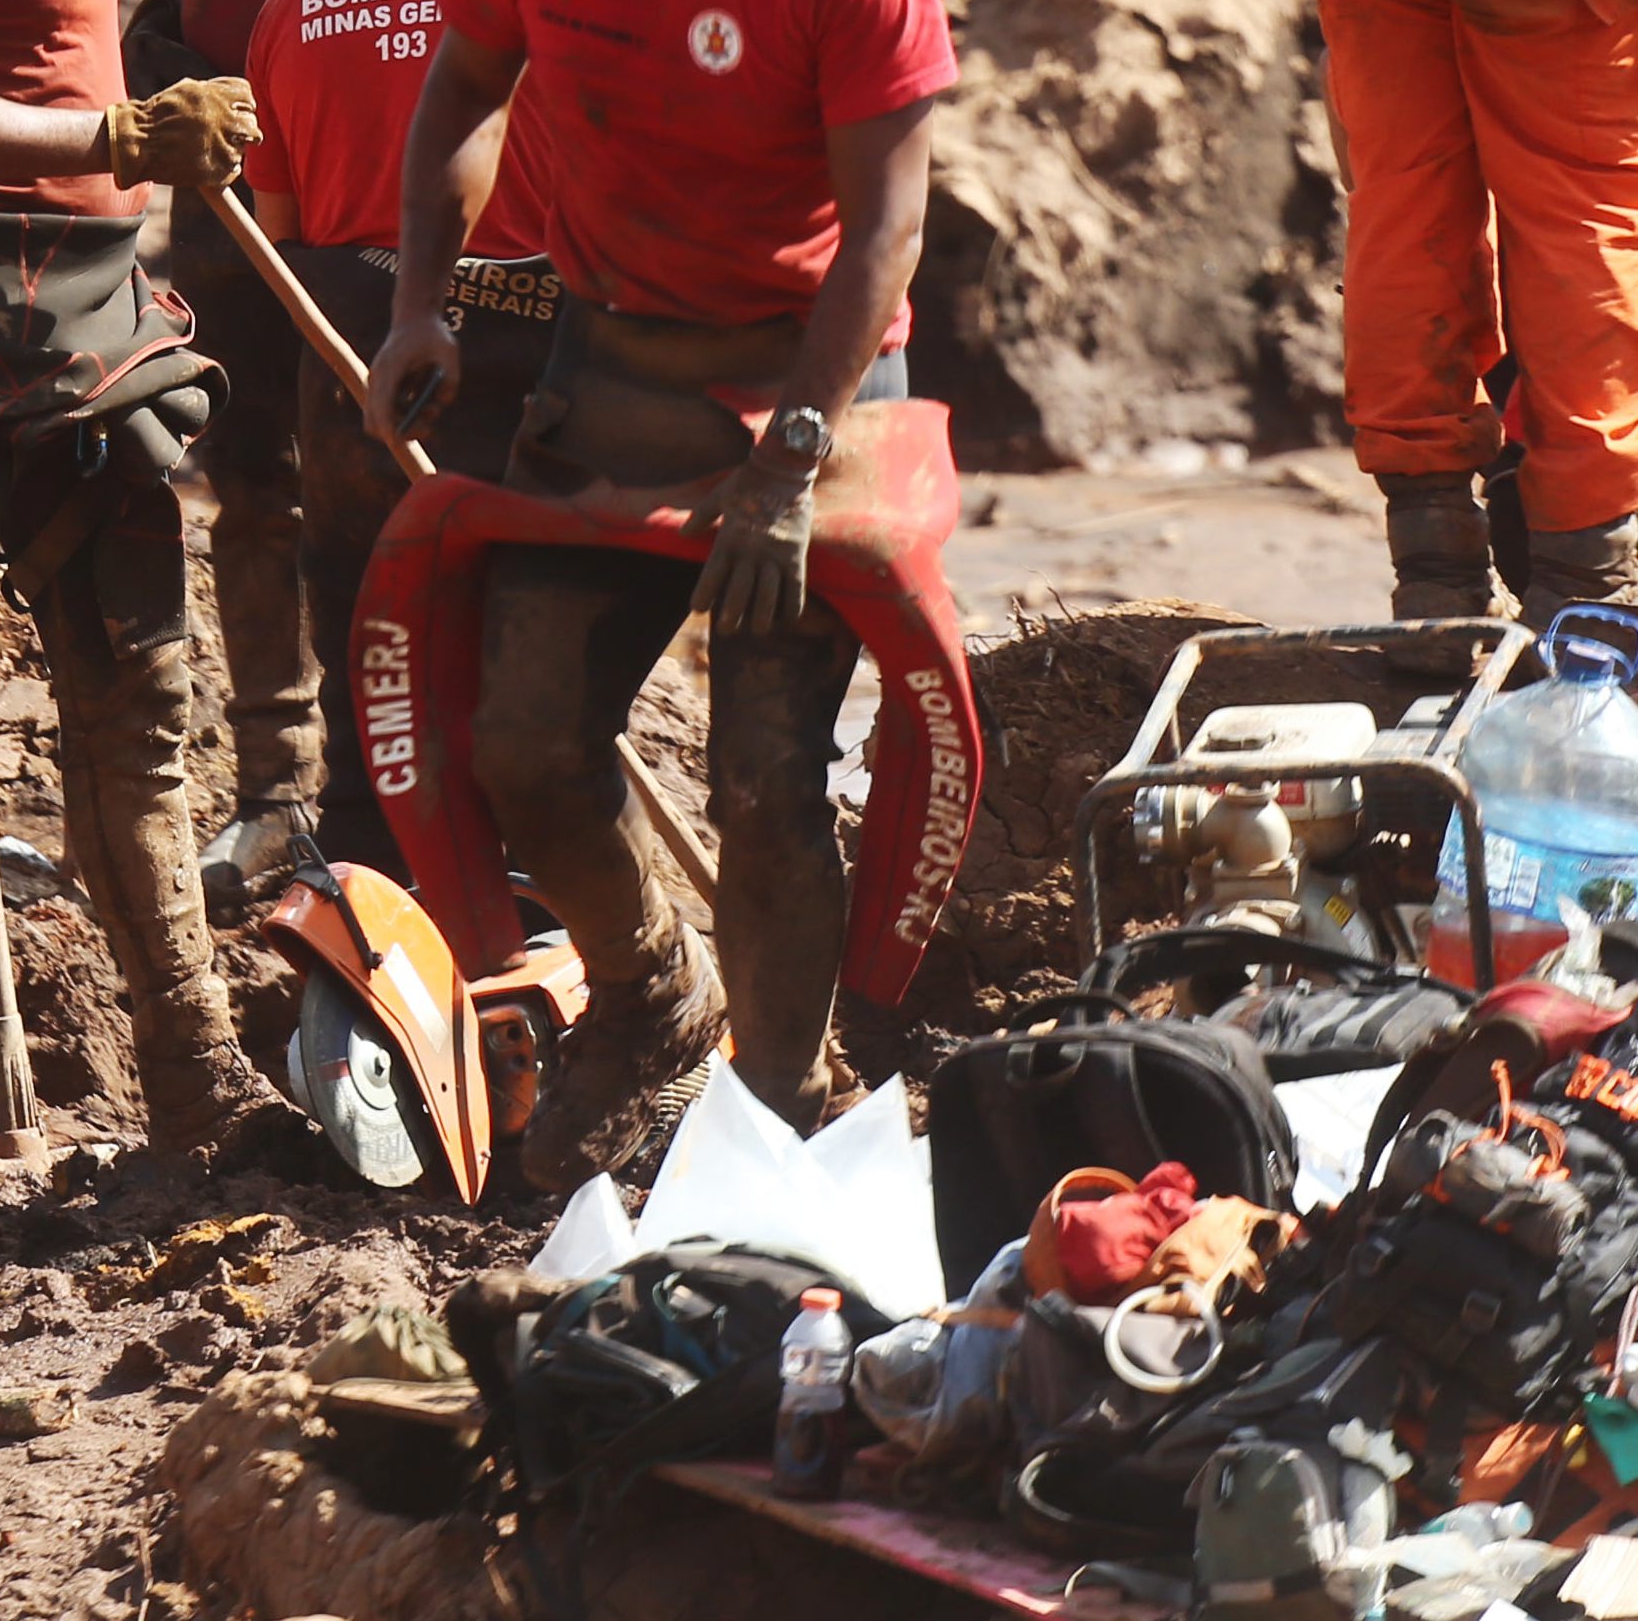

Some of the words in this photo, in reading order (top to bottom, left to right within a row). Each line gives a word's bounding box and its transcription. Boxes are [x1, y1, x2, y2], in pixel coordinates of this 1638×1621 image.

[301, 5, 391, 43] MINAS
[399, 0, 442, 25] GE
[375, 30, 427, 61] 193
[358, 247, 401, 275] MIN
[363, 618, 418, 796] CBMERJ
